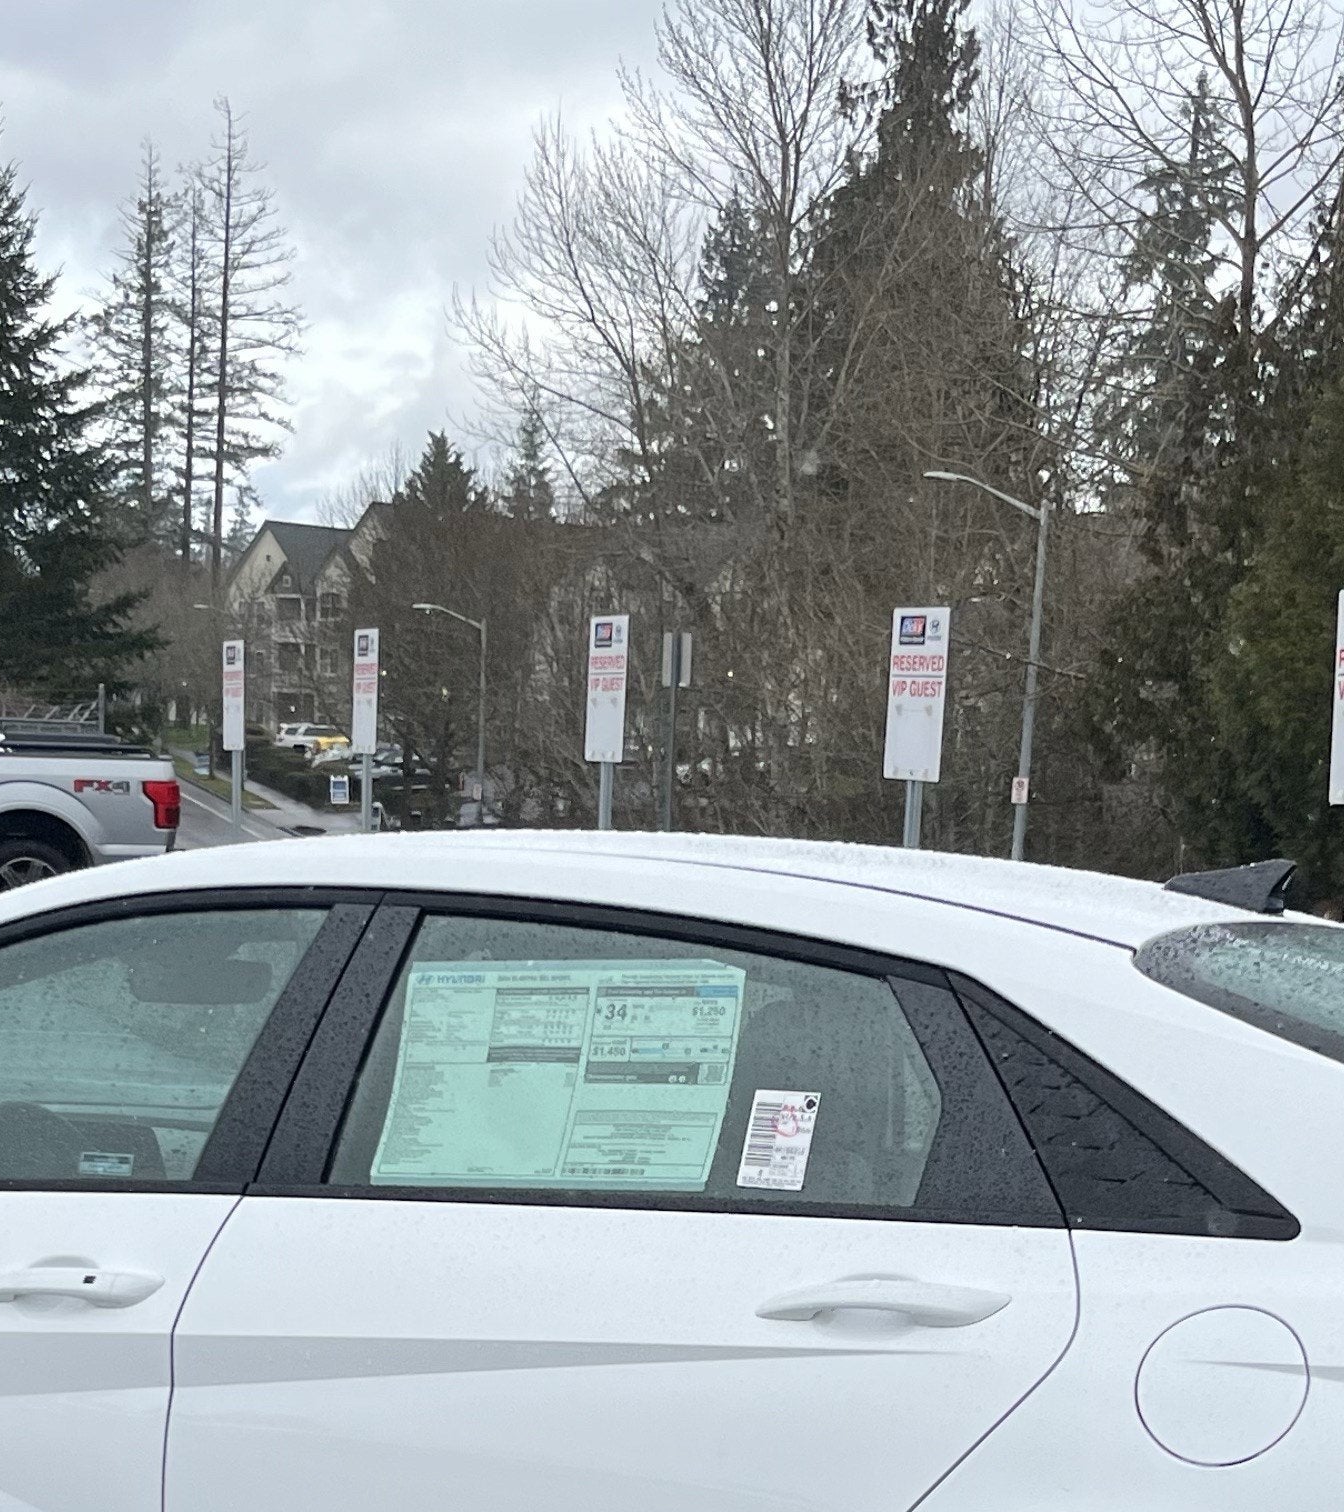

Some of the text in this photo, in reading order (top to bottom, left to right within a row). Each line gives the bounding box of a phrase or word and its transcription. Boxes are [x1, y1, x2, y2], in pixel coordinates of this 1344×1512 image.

[892, 654, 945, 672] RESERVED
[892, 680, 943, 698] VIP GUEST
